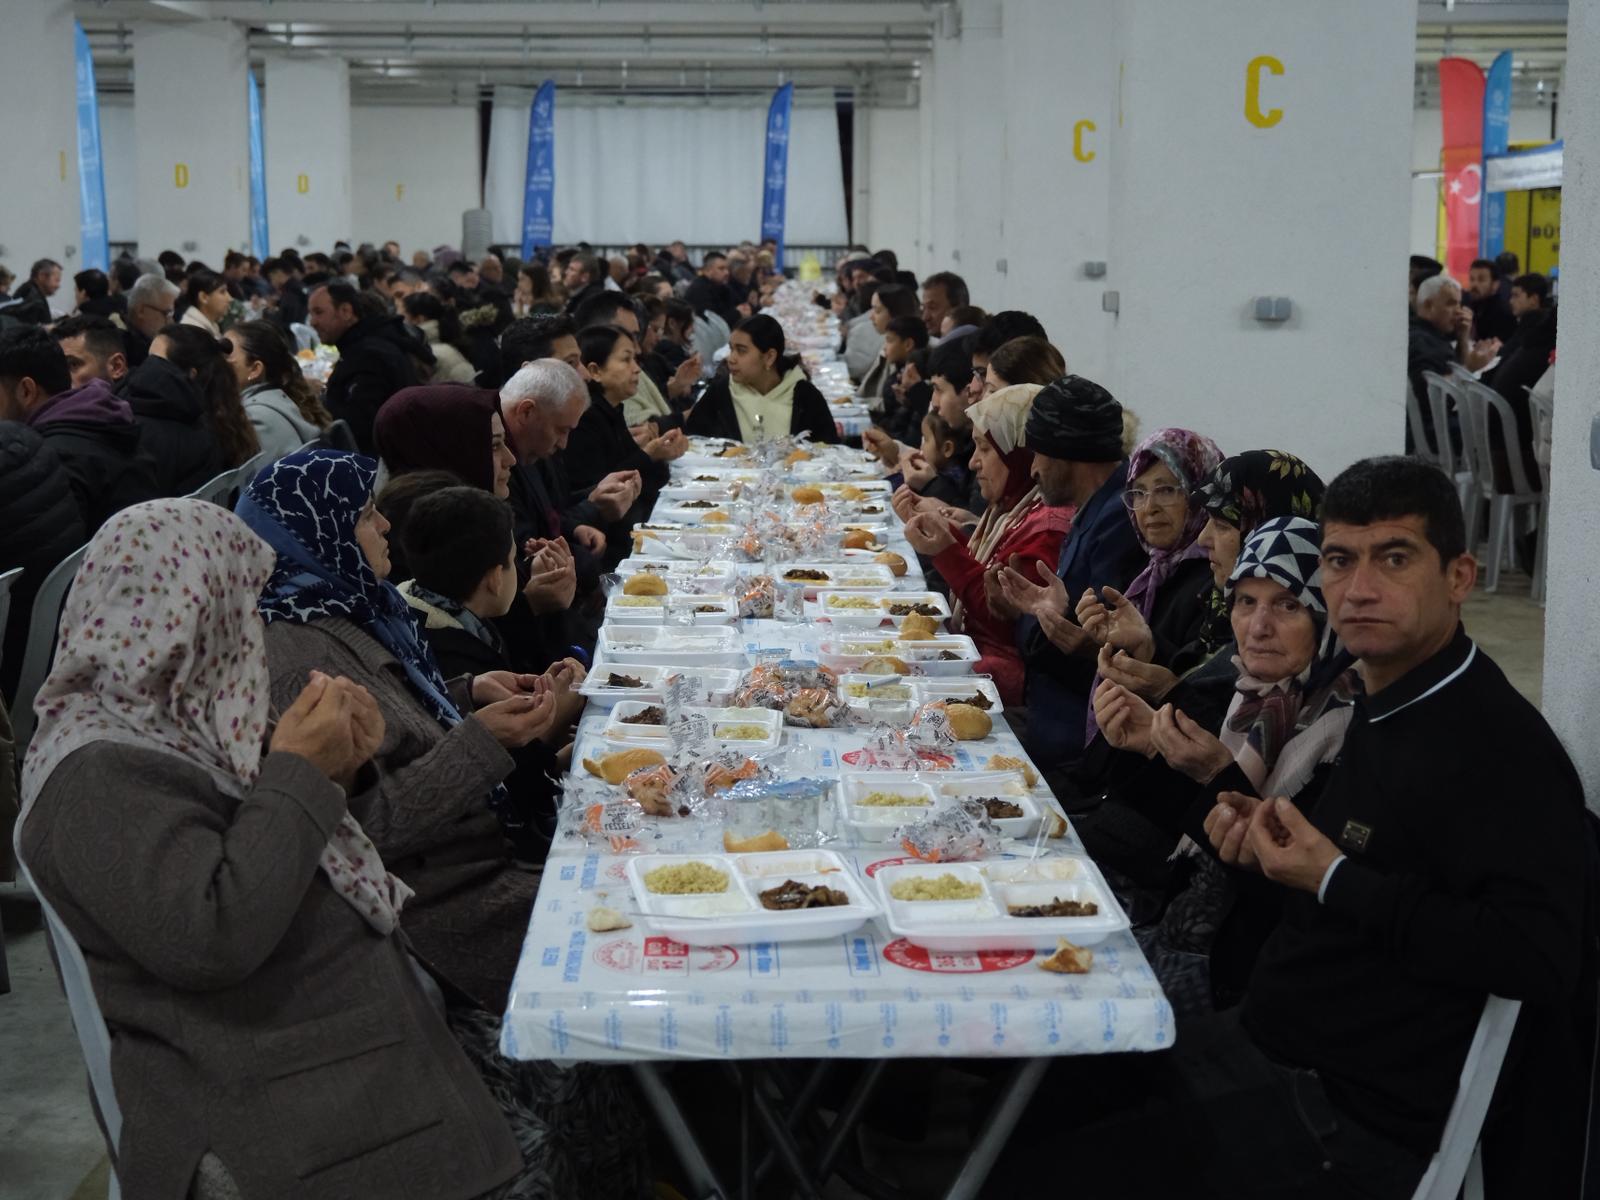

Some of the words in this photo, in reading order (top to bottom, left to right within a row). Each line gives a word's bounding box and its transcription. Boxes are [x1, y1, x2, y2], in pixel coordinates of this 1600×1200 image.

[1244, 55, 1285, 128] C
[1073, 119, 1096, 163] C
[175, 163, 189, 188] D
